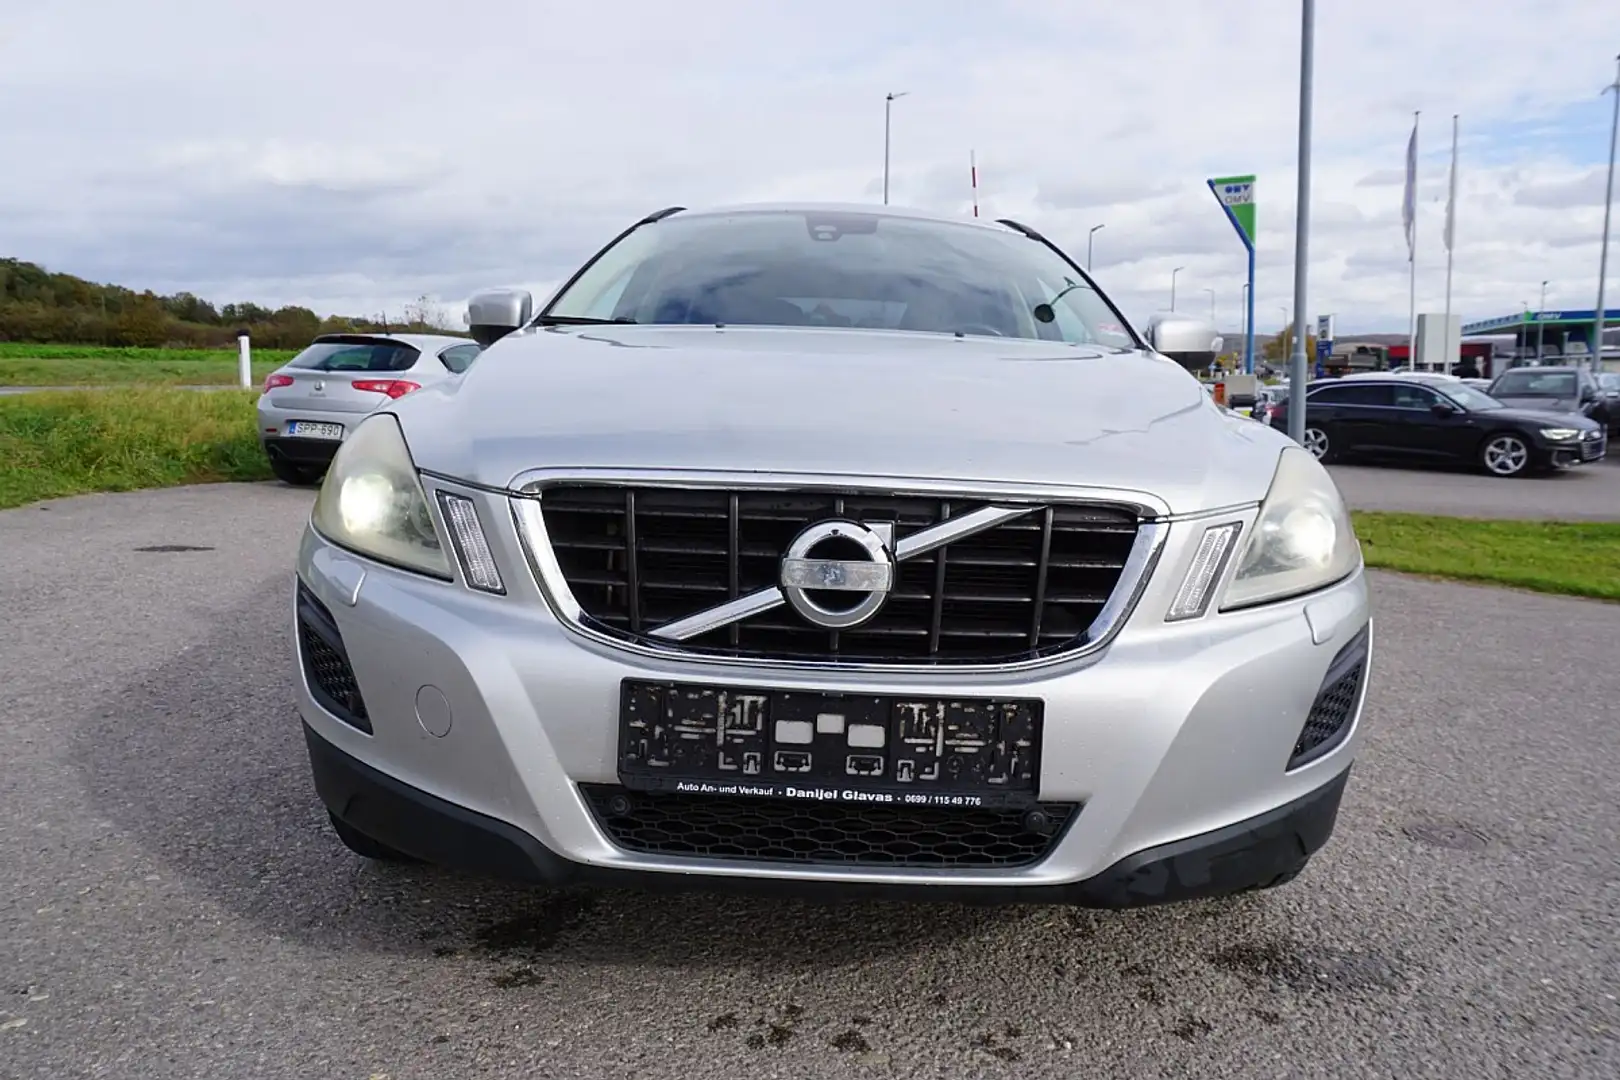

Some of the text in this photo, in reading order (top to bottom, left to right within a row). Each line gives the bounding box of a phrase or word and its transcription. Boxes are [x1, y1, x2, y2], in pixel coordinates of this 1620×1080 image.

[1225, 193, 1250, 204] OMV
[297, 422, 339, 436] SPP-690
[677, 782, 699, 792] Auto
[700, 783, 717, 793] An-
[719, 785, 737, 794] und
[738, 786, 774, 796] Verkauf
[785, 787, 838, 801] Danijel
[842, 789, 894, 803] Glavas
[904, 794, 927, 803] 0699
[934, 795, 950, 805] 115
[951, 796, 963, 805] 49
[965, 796, 982, 806] 776
